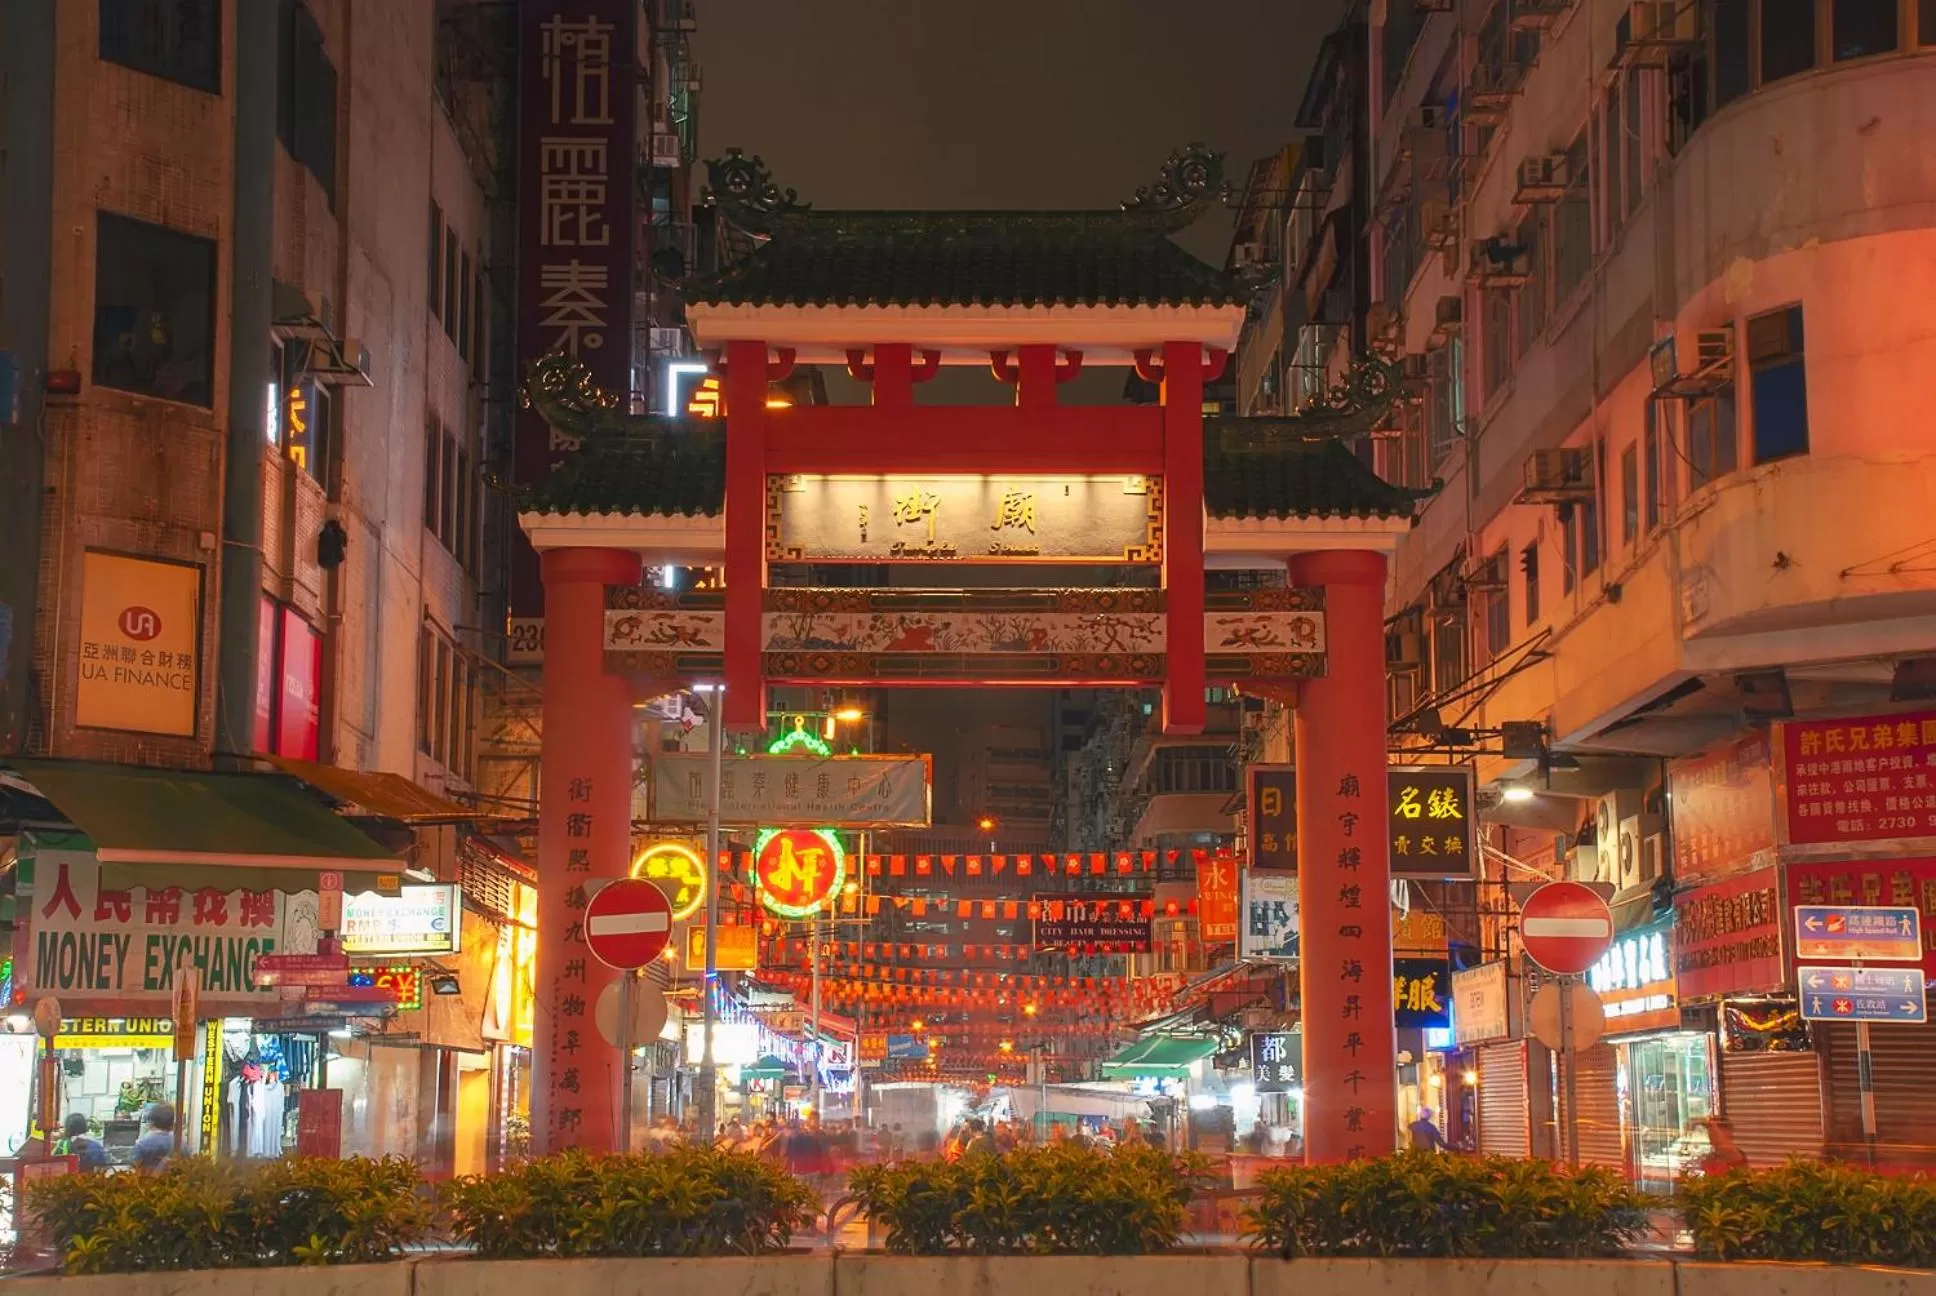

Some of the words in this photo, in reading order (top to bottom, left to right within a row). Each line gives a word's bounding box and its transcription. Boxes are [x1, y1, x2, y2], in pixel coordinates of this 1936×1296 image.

[83, 641, 193, 671] 亞洲聯合財務
[82, 663, 108, 681] UA
[114, 667, 193, 691] FINANCE
[1394, 785, 1463, 820] 名錶
[1878, 816, 1916, 830] 2730
[1070, 927, 1094, 937] HAIR
[1100, 927, 1145, 937] DRESSING
[36, 931, 131, 990] MONEY
[557, 778, 594, 1151] 街衢熙攘九州物阜萬邦
[125, 1018, 173, 1033] UNIO
[205, 1022, 218, 1083] WESTERN
[1256, 1064, 1296, 1083] 美髮
[203, 1087, 214, 1131] UNION
